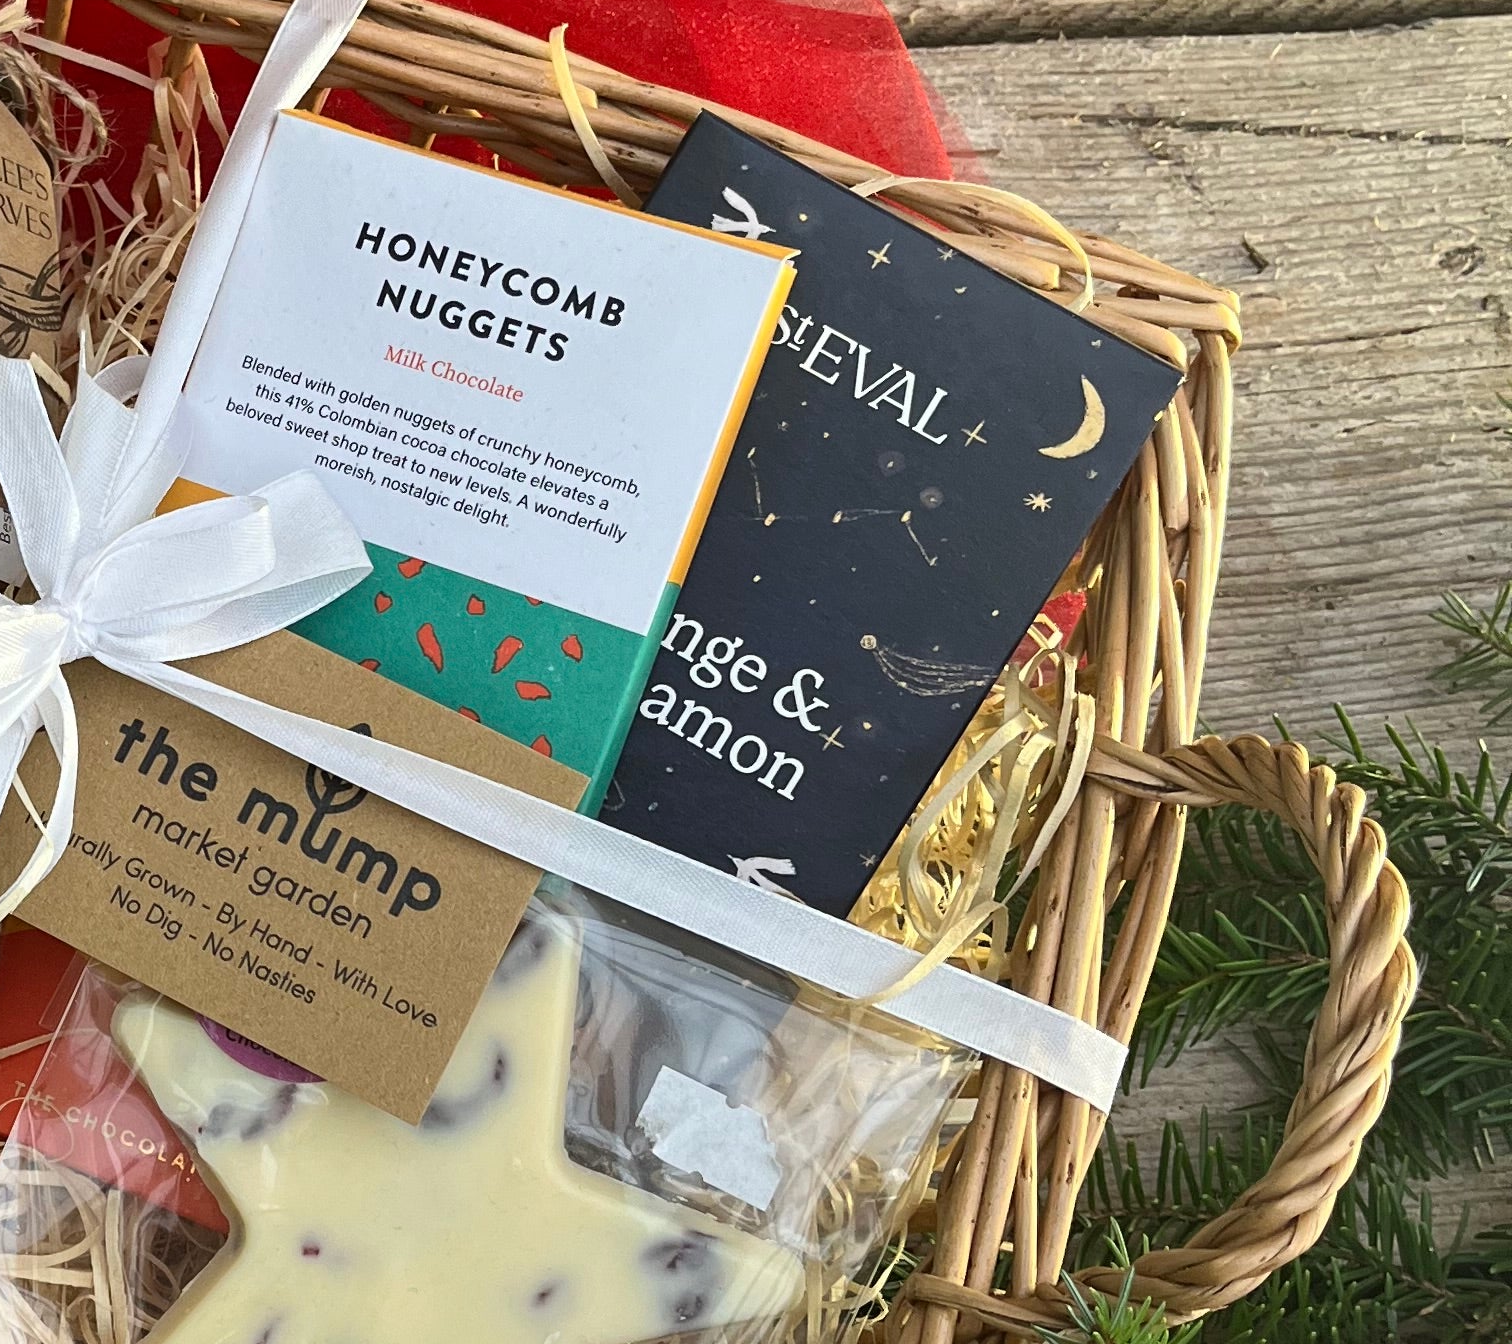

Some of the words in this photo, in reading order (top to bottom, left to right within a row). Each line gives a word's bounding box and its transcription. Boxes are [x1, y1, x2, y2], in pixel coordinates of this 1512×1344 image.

[355, 222, 626, 327] HONEYCOMB
[376, 279, 569, 362] NUGGETS
[241, 355, 302, 386] Blended
[305, 377, 336, 397] with
[338, 389, 390, 415] golden
[393, 407, 455, 435] nuggets
[459, 427, 477, 441] of
[477, 434, 541, 465] crunchy
[544, 452, 641, 498] honeycomb,
[384, 344, 426, 373] Milk
[431, 360, 525, 403] Chocolate
[799, 325, 948, 445] EVAL
[225, 397, 284, 428] beloved
[285, 420, 329, 443] sweet
[331, 433, 368, 457] shop
[372, 445, 408, 469] treat
[411, 458, 426, 475] to
[429, 467, 463, 487] new
[465, 476, 512, 504] levels.
[516, 494, 529, 510] A
[533, 501, 627, 544] wonderfully
[255, 384, 281, 404] this
[285, 394, 314, 414] 41%
[318, 404, 398, 441] Colombian
[401, 434, 447, 457] cocoa
[451, 449, 527, 483] chocolate
[530, 475, 596, 506] elevates
[599, 499, 609, 511] a
[314, 453, 377, 485] moreish,
[380, 474, 451, 508] nostalgic
[453, 498, 510, 528] delight.
[772, 668, 830, 733] &
[114, 718, 218, 802] the
[237, 787, 442, 918] mump
[131, 803, 250, 875] market
[248, 865, 373, 940] garden
[110, 884, 142, 915] No
[145, 903, 183, 941] Dig
[202, 931, 235, 962] No
[238, 950, 317, 1005] Nasties
[125, 857, 197, 907] Grown
[216, 901, 248, 935] By
[250, 918, 314, 966] Hand
[333, 959, 378, 1000] With
[382, 986, 438, 1028] Love
[15, 1080, 55, 1113] THE
